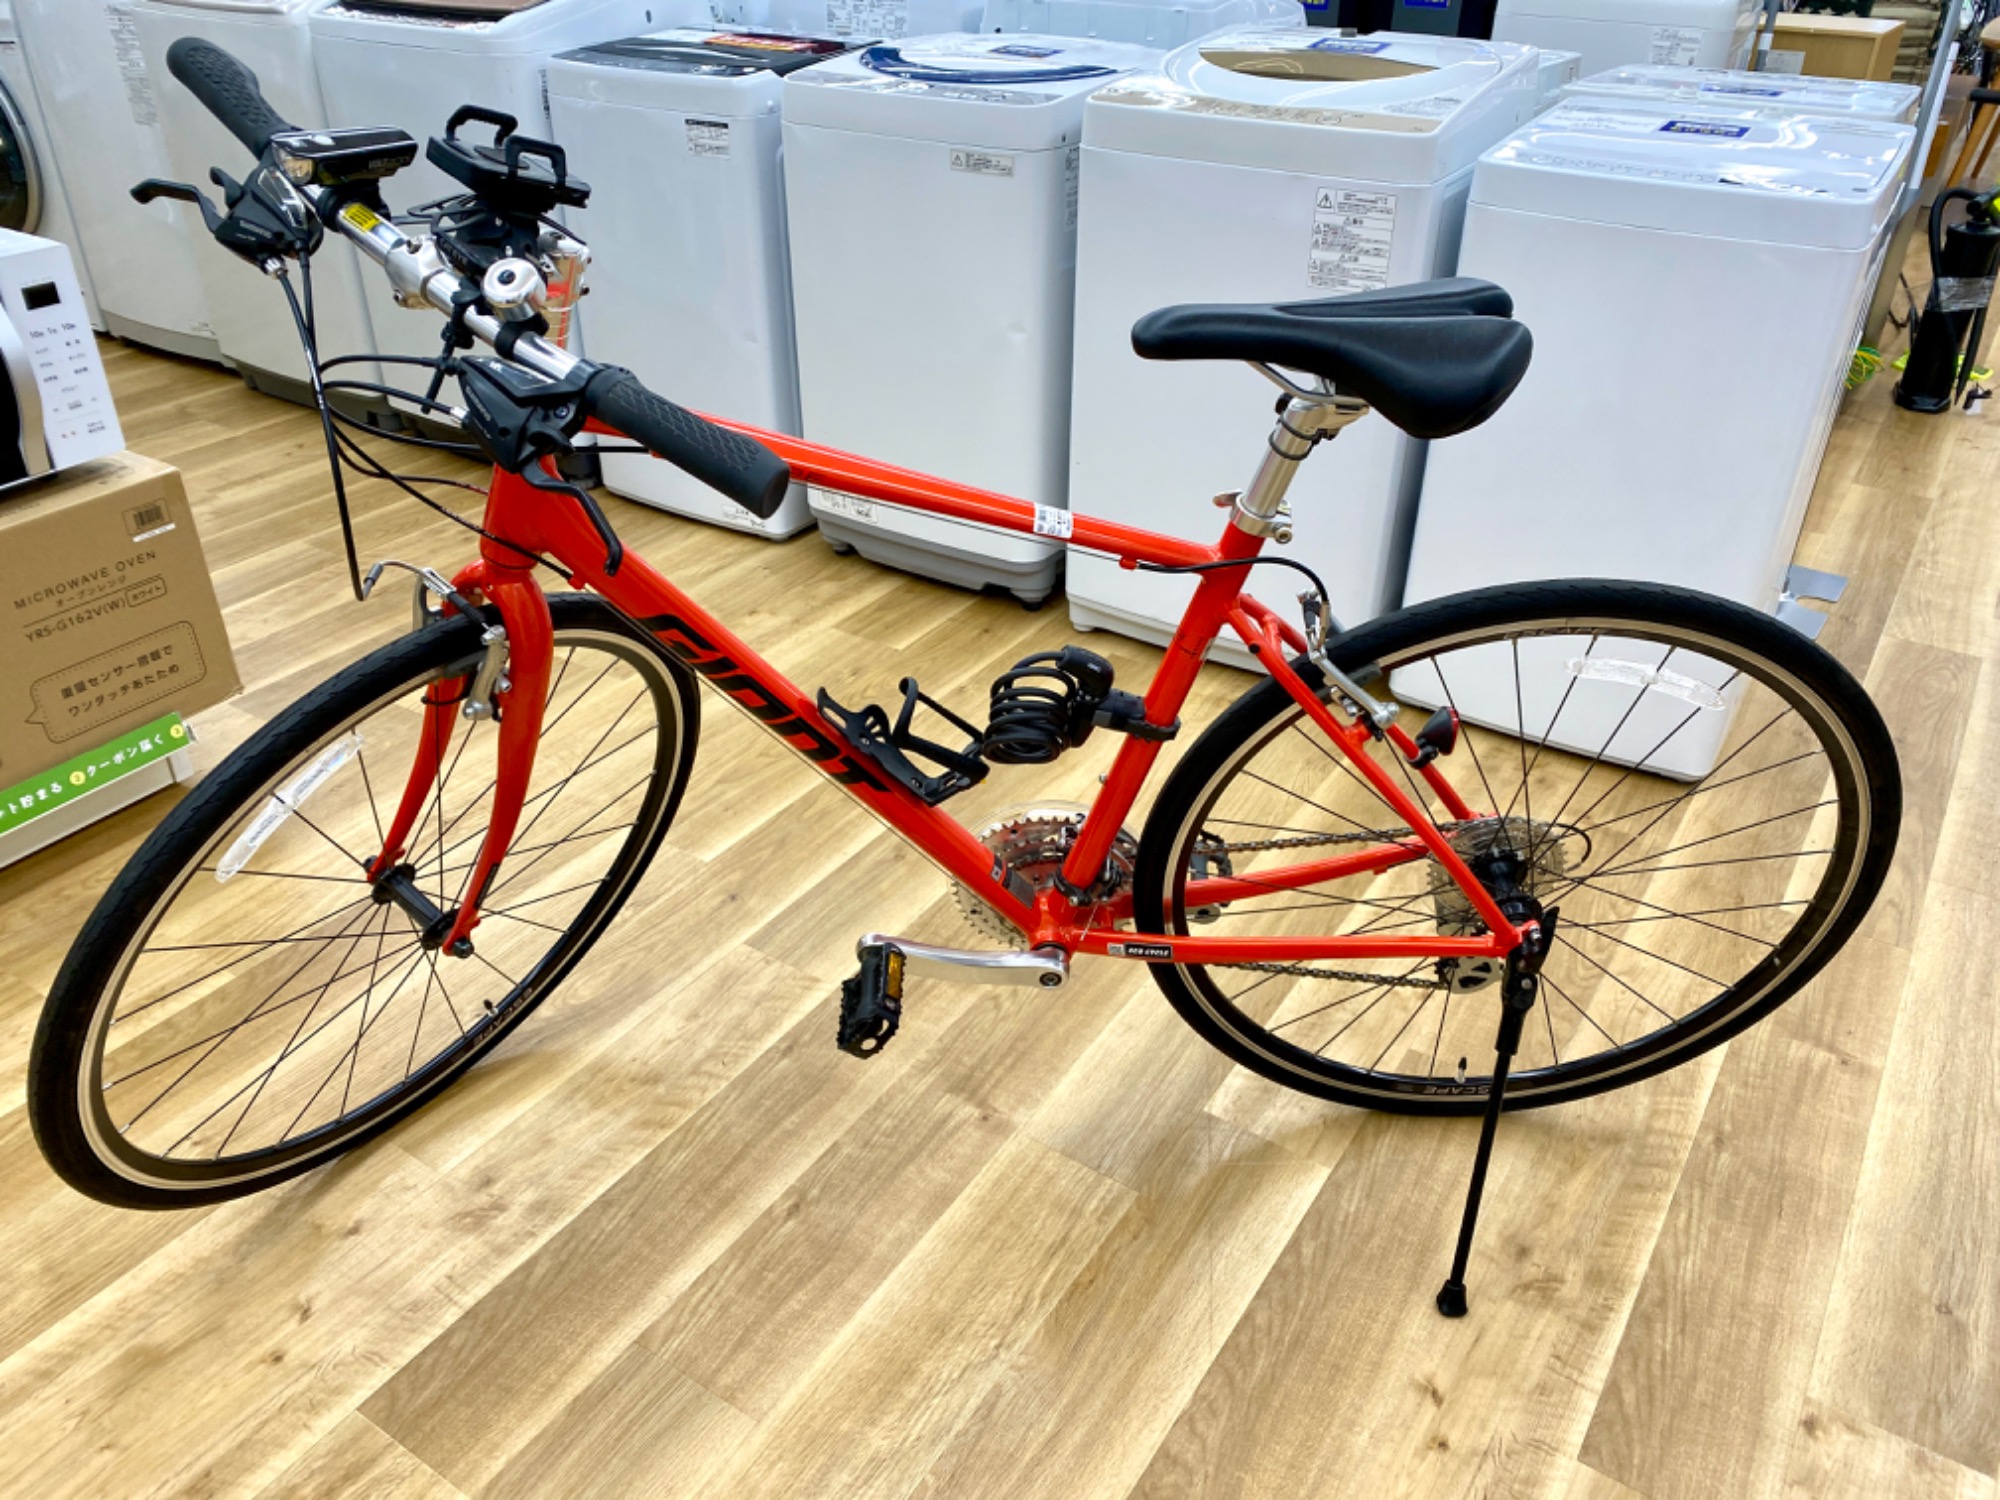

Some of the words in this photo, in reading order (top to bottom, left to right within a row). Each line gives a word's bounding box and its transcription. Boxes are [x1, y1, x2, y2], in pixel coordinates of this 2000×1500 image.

[13, 566, 110, 609] MICROWAVE
[115, 550, 157, 572] OVEN
[68, 663, 180, 719] ワンタッチあたため
[1422, 1084, 1492, 1095] SCAPE
